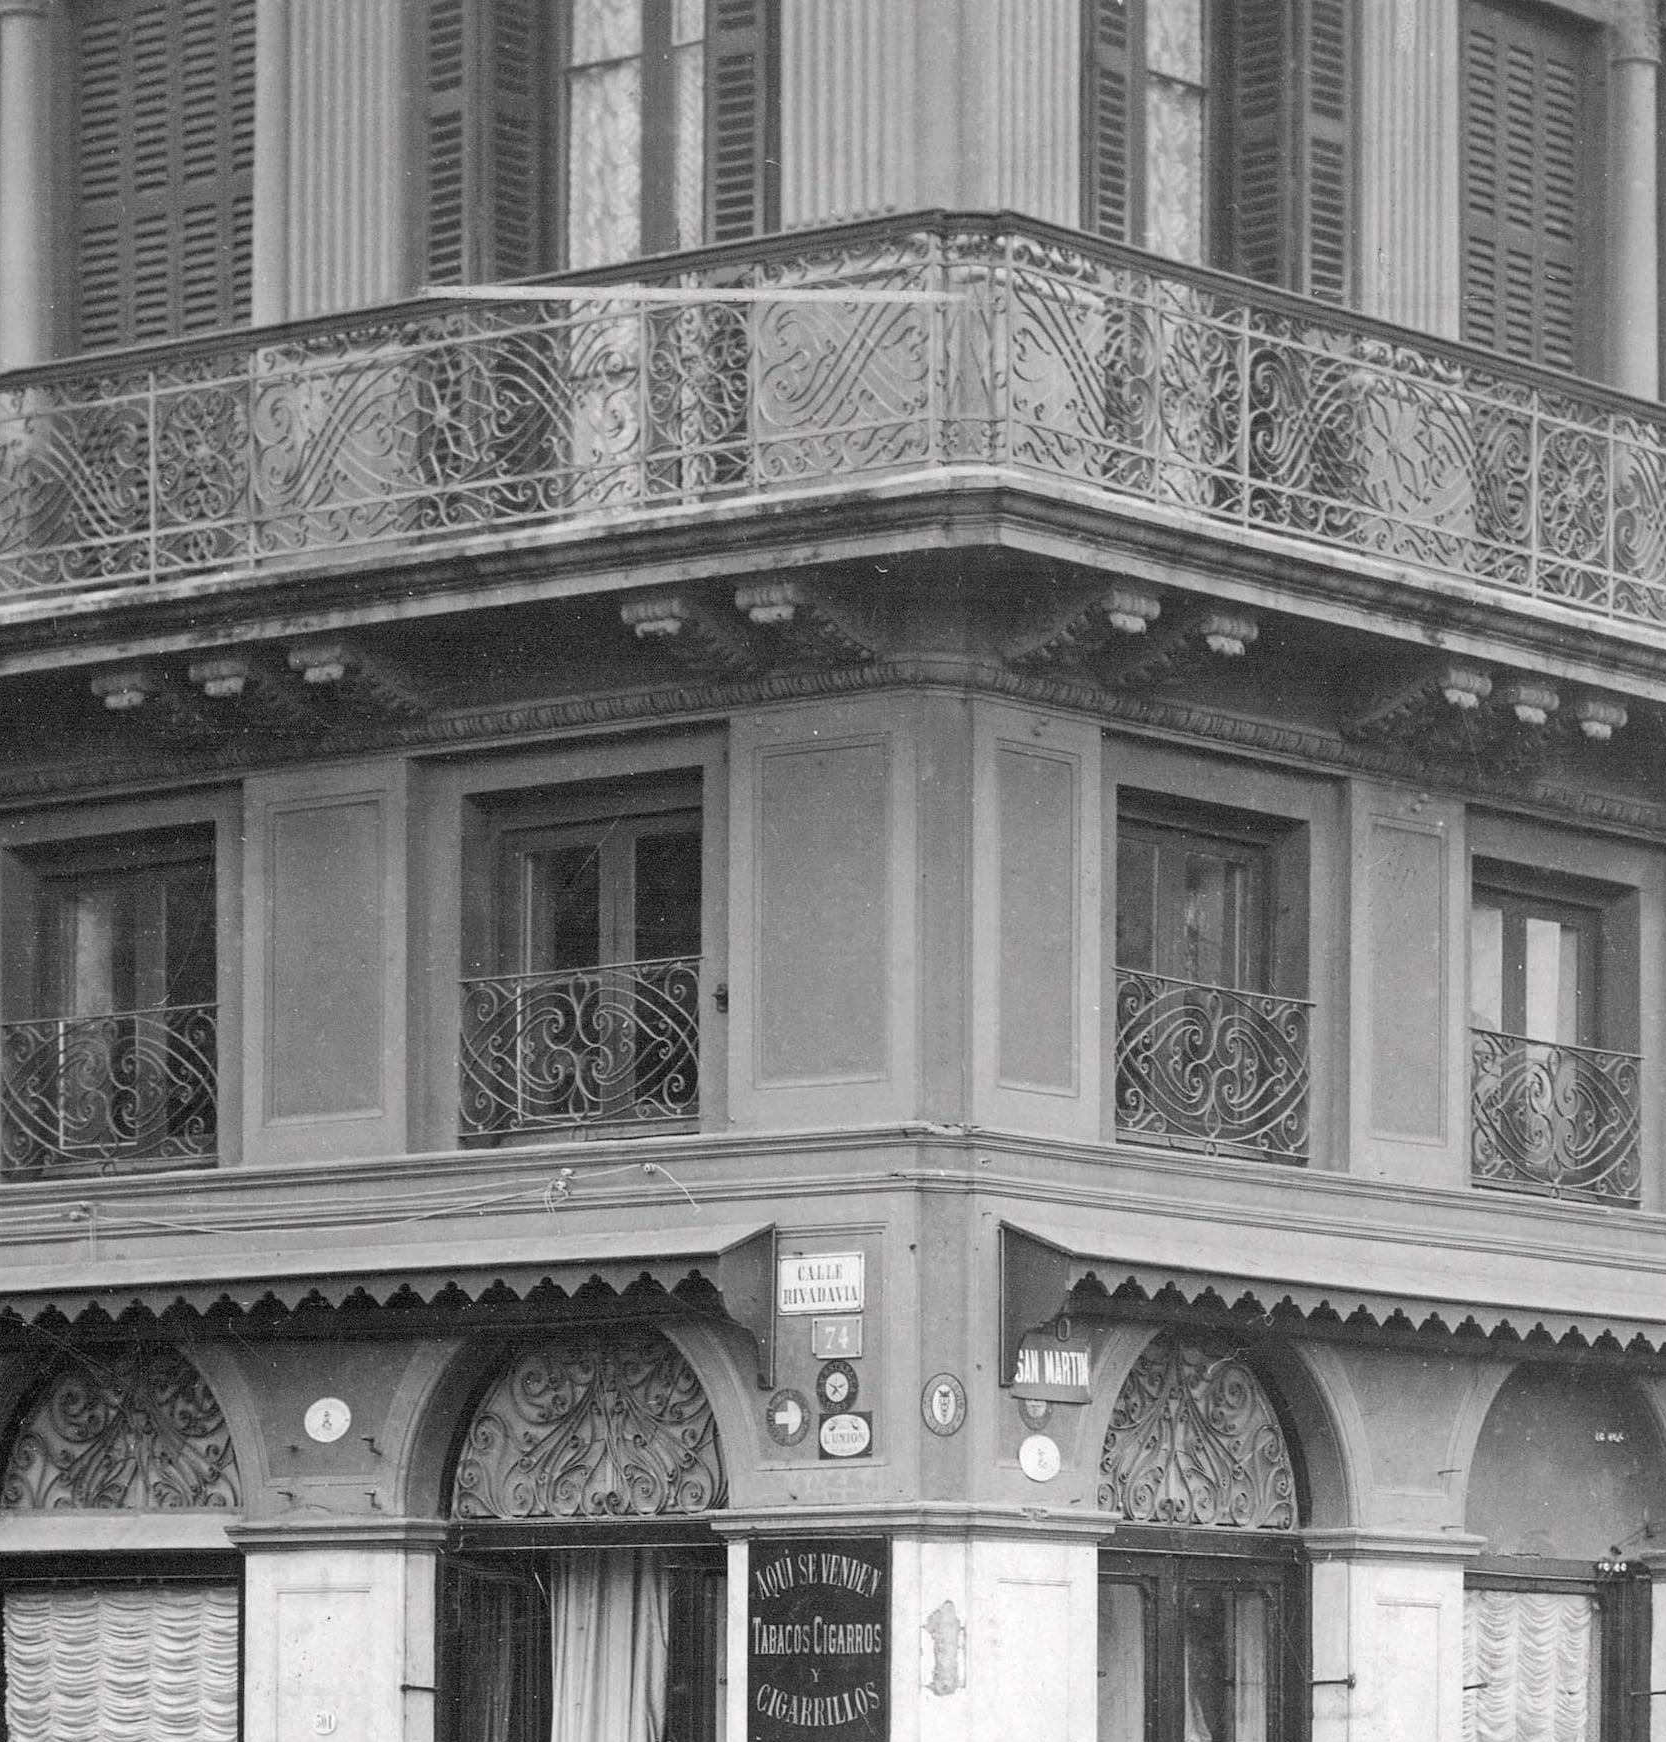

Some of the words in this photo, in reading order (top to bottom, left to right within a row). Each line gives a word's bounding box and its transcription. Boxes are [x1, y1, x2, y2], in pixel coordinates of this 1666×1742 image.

[797, 1264, 843, 1281] CALLE
[783, 1285, 858, 1305] RIVADAVIA
[825, 1326, 849, 1349] 74
[1015, 1349, 1039, 1384] SAN
[1044, 1350, 1089, 1386] MARTIN
[798, 1553, 818, 1584] SE
[821, 1553, 882, 1597] VENDEN
[753, 1617, 810, 1654] TABACOS
[813, 1616, 882, 1654] CIGARROS
[811, 1668, 821, 1682] Y
[757, 1682, 880, 1727] CIGARRILLOS
